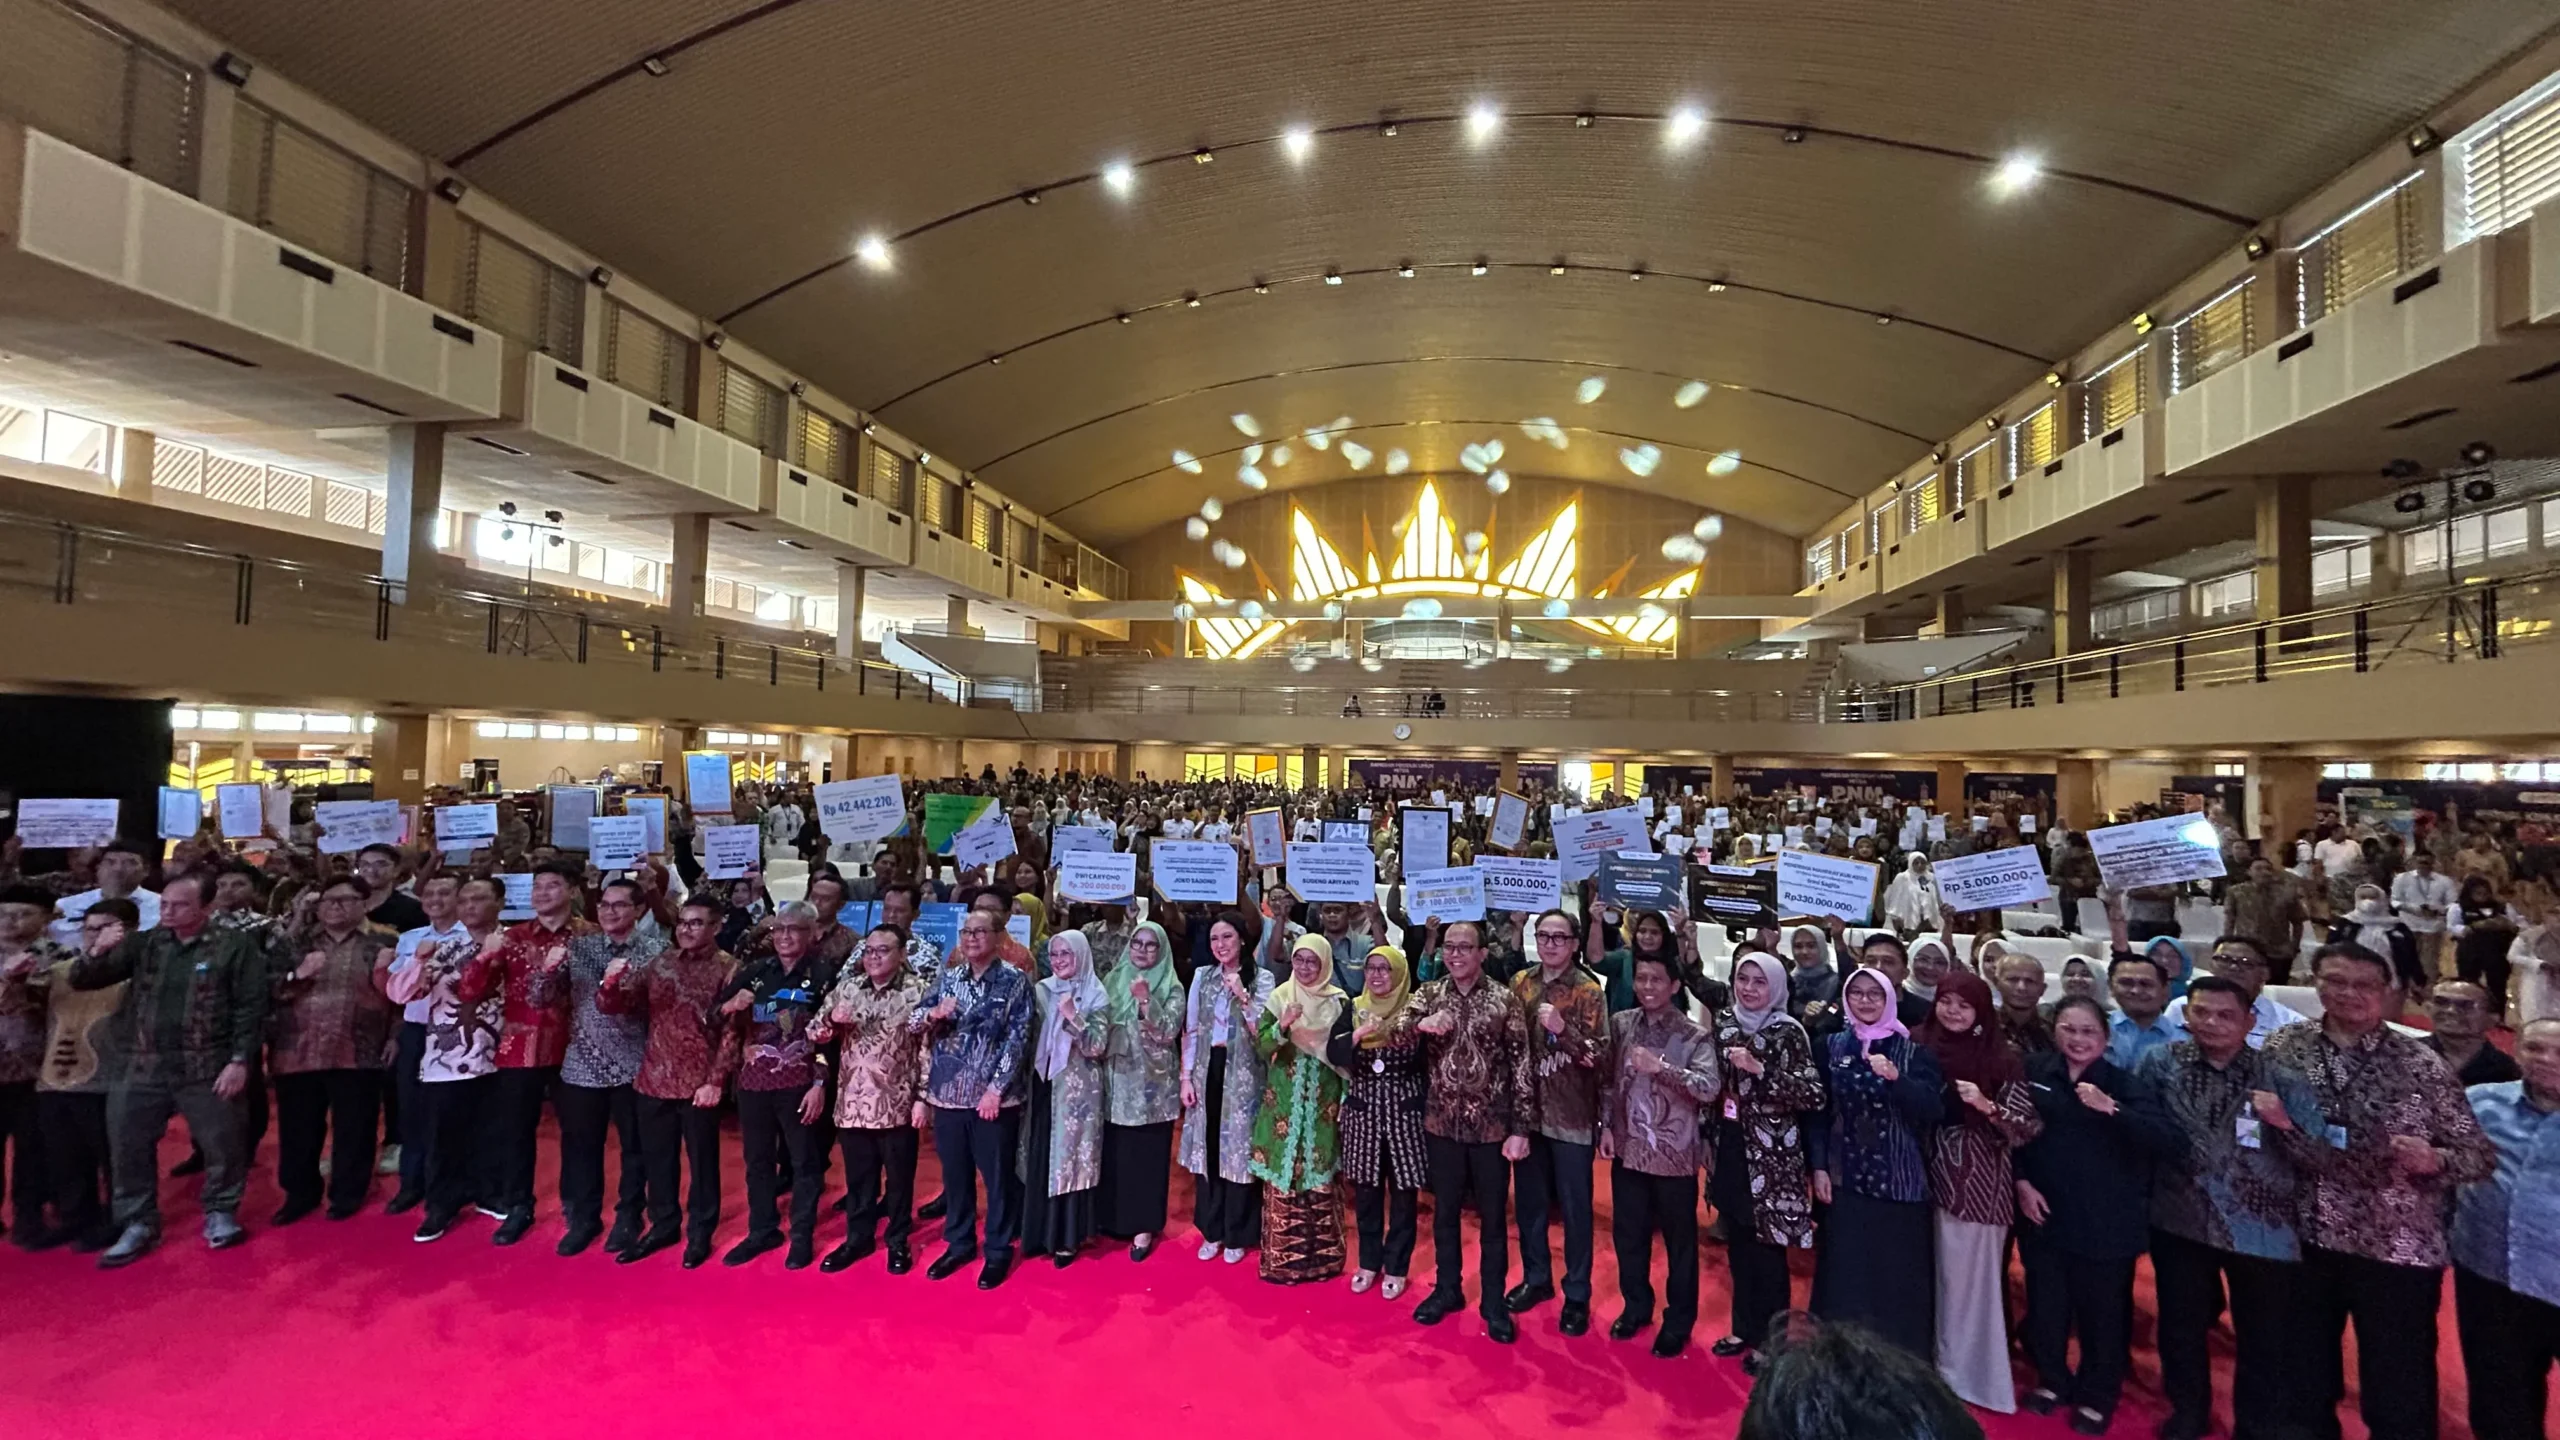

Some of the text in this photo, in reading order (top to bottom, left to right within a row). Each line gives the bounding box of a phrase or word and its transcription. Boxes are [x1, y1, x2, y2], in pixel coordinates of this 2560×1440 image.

[1832, 785, 1884, 801] PNM
[823, 804, 836, 816] Rp
[1483, 876, 1557, 893] p.5.000.000,-
[1943, 870, 2039, 894] Rp.5.000.000,-
